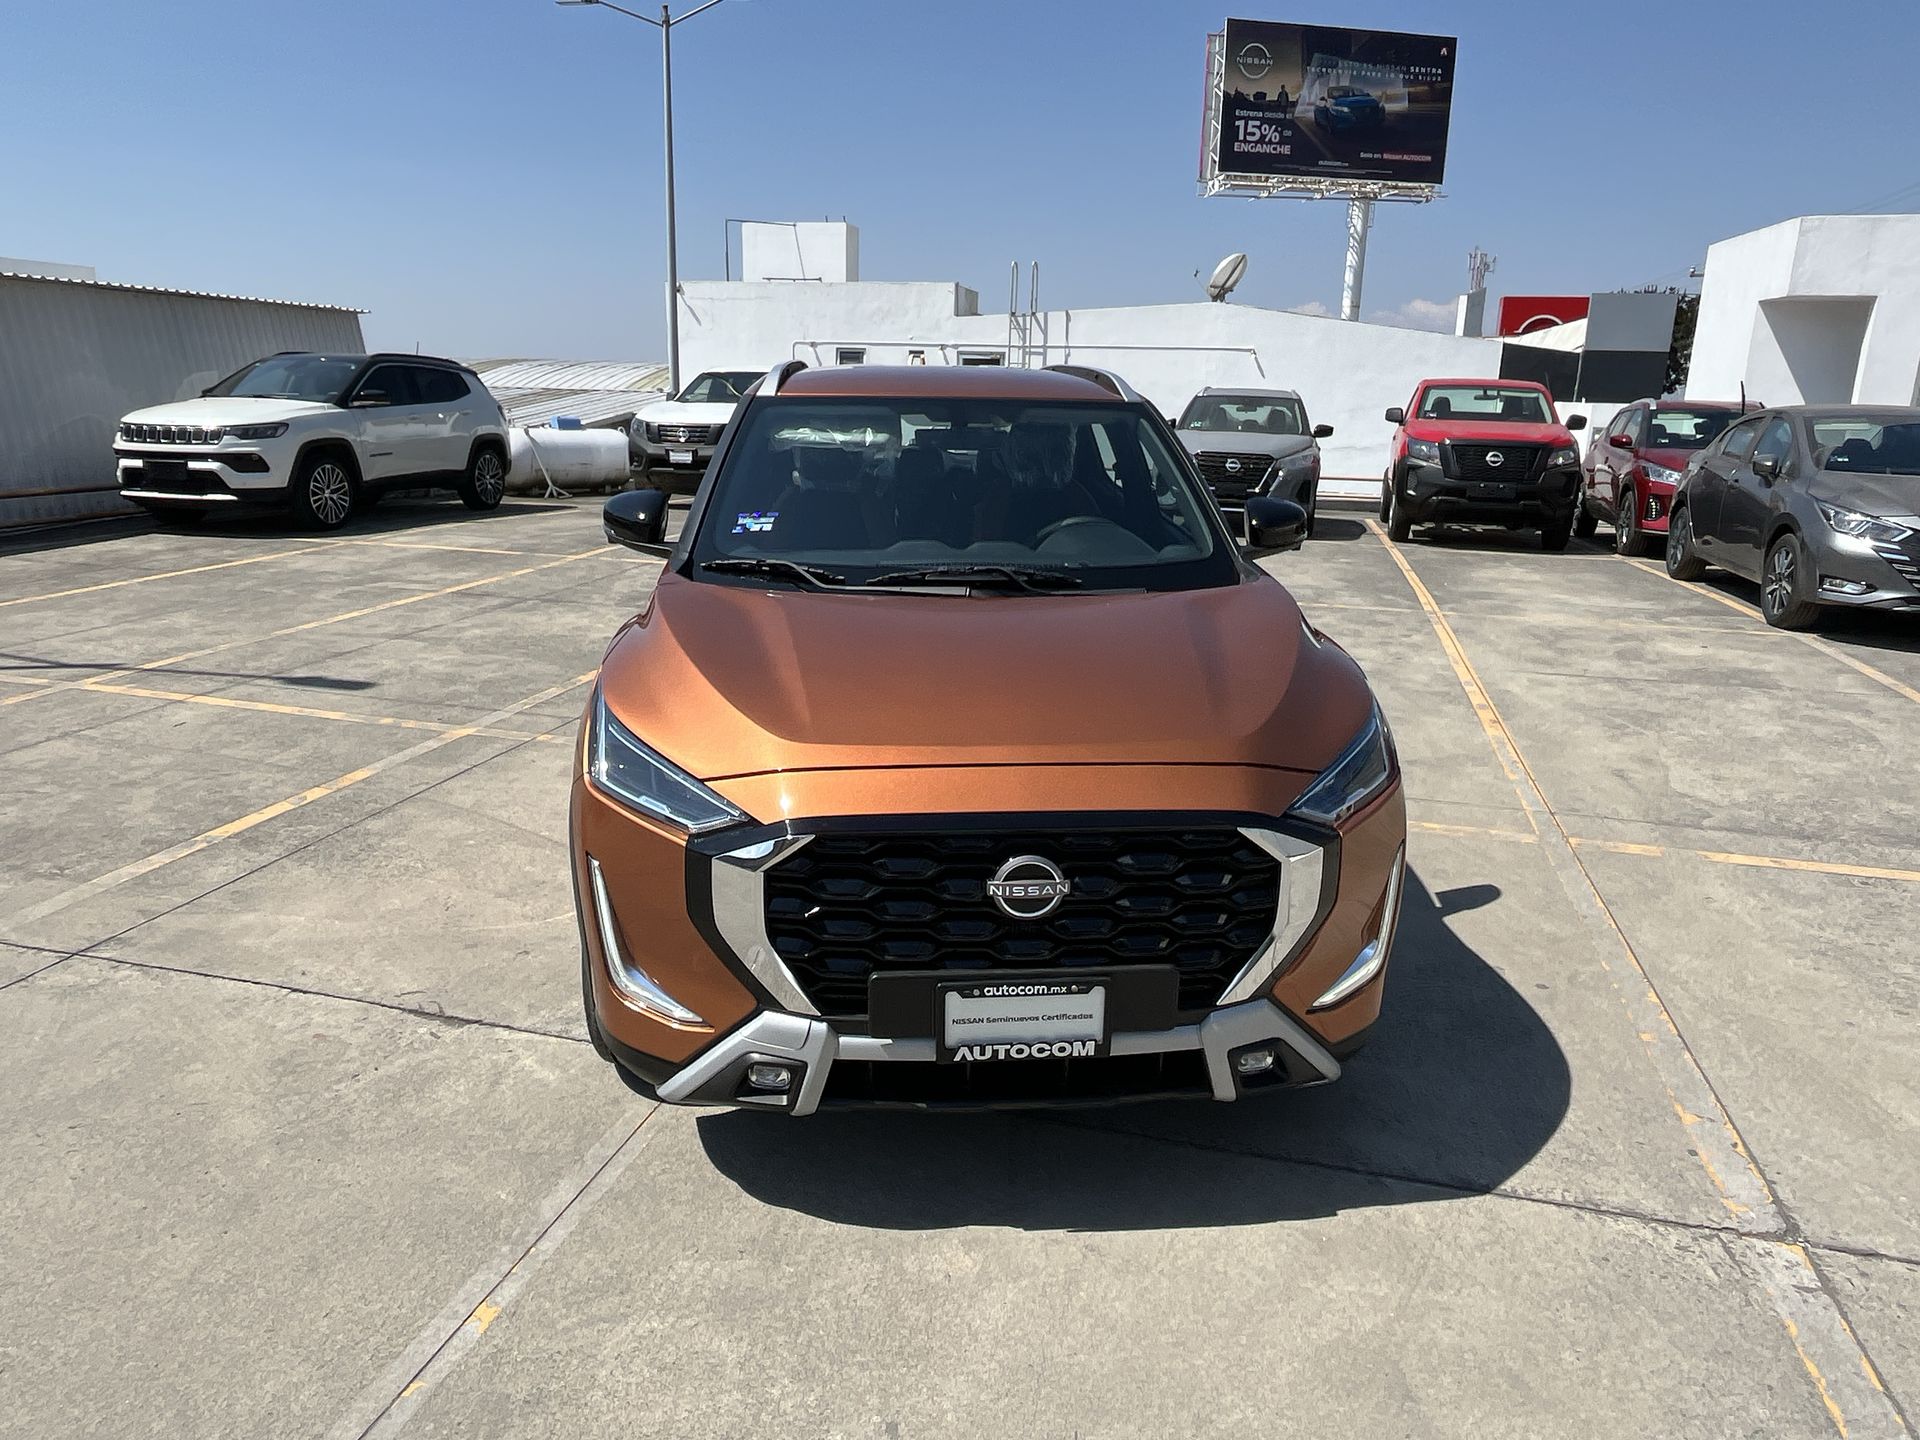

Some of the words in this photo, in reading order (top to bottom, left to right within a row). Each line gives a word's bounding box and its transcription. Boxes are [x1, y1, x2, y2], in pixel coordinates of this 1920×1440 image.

[1236, 56, 1273, 65] NISSAN
[1410, 66, 1442, 74] SENTRA
[1235, 108, 1263, 118] Estrena
[1234, 142, 1291, 155] ENGANCHE
[989, 882, 1068, 897] NISSAN
[983, 984, 1067, 996] autocom.mx
[952, 1016, 984, 1025] NISSAN
[986, 1015, 1039, 1024] Seminuevos
[1041, 1013, 1094, 1021] Certificados
[953, 1040, 1096, 1062] AUTOCOM
